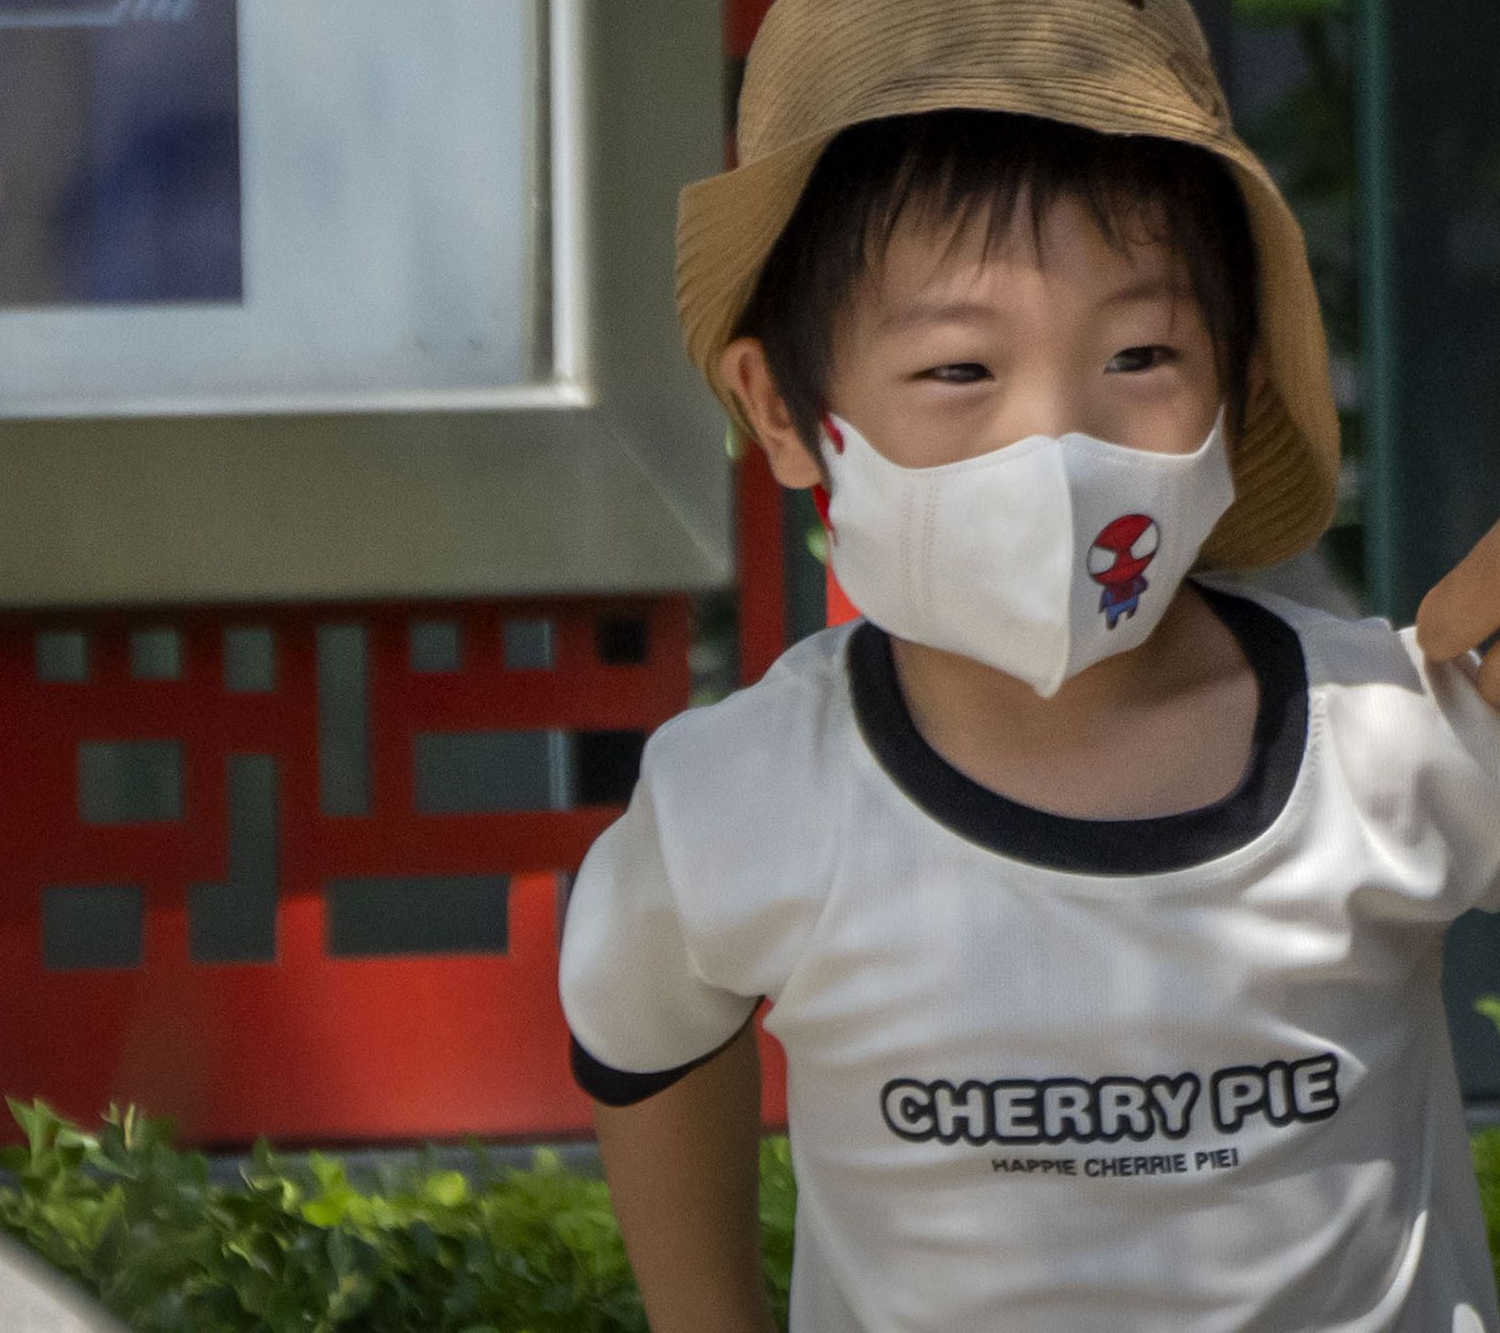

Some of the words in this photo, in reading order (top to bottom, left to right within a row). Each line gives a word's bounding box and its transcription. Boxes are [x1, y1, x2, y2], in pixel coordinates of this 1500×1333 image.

[880, 1073, 1200, 1145] CHERRY
[1210, 1053, 1338, 1133] PIE
[991, 1158, 1076, 1176] HAPPIE
[1084, 1153, 1188, 1177] CHERRIE
